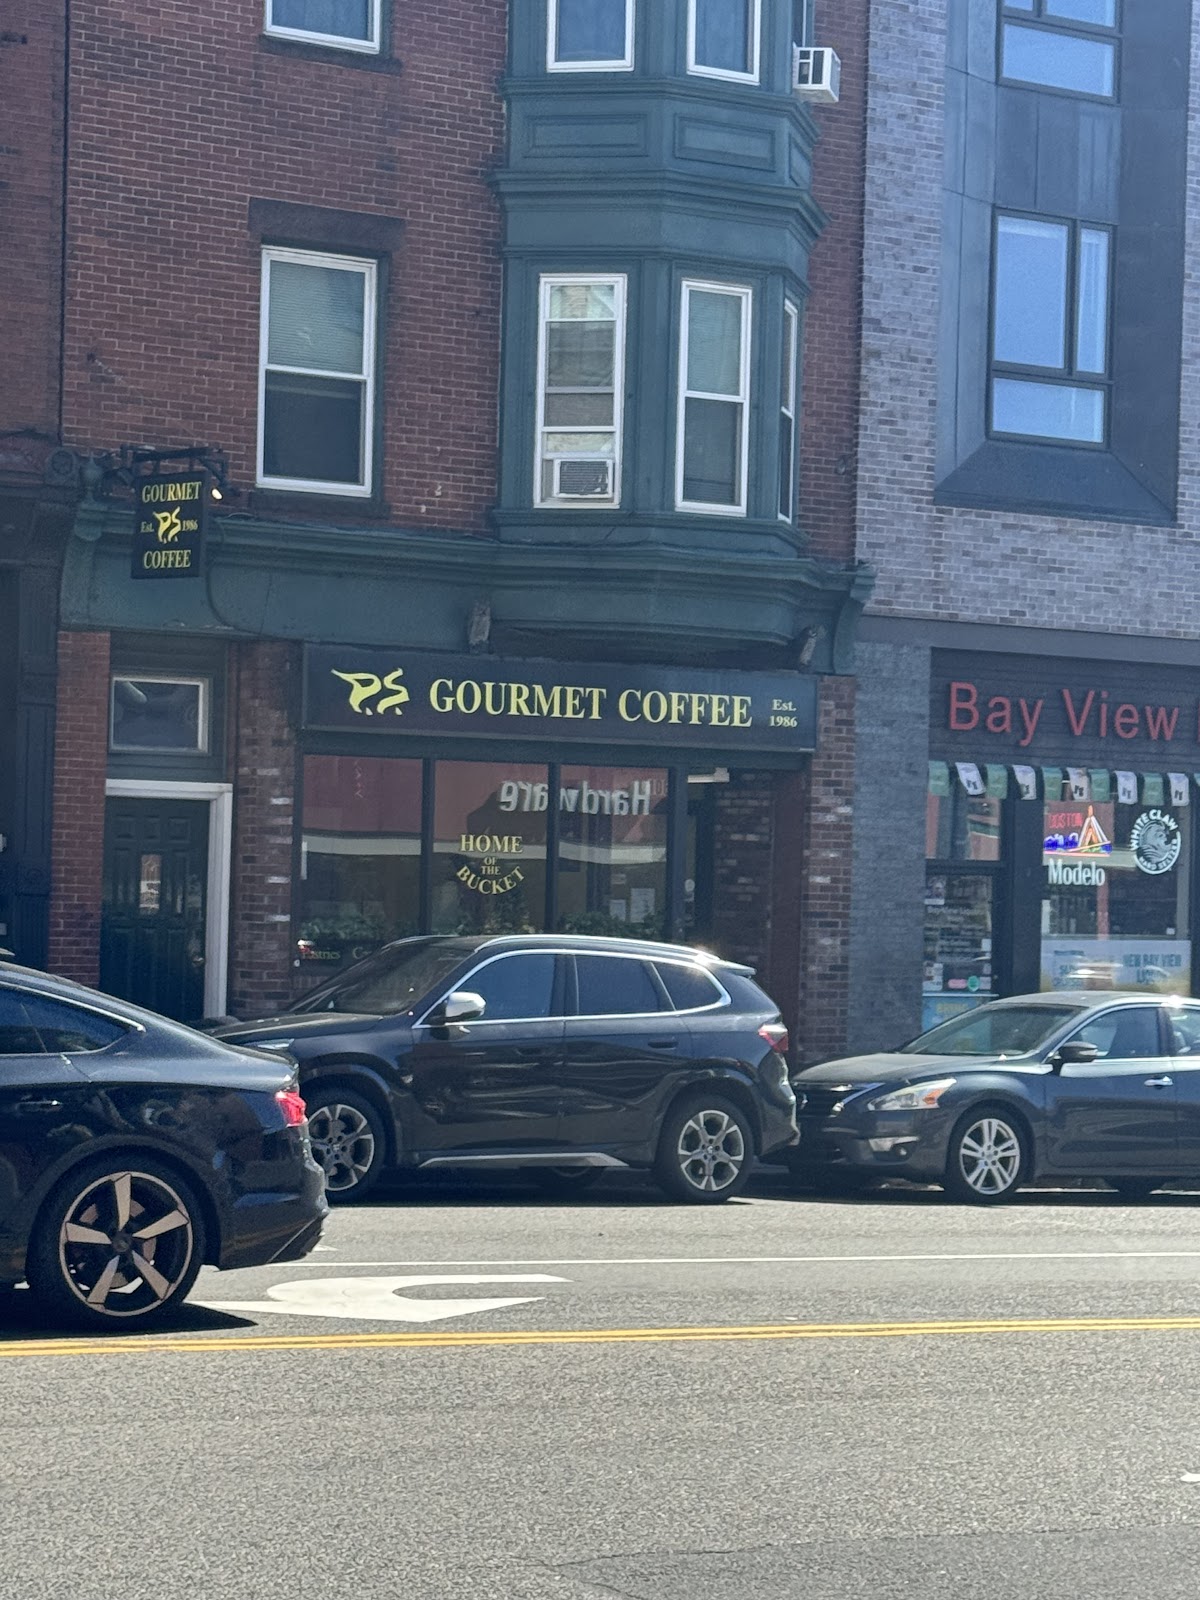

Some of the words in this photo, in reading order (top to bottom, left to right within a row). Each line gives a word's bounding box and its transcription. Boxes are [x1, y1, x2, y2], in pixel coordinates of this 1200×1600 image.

[141, 481, 202, 503] GOURMET
[140, 522, 154, 533] Est.
[182, 520, 198, 531] 1986
[143, 550, 191, 569] COFFEE
[429, 678, 606, 720] GOURMET
[618, 689, 753, 727] COFFEE
[772, 698, 796, 712] Est.
[769, 714, 798, 728] 1986
[949, 681, 1043, 747] Bay
[1063, 688, 1179, 741] View
[1129, 813, 1150, 851] WHITE
[1149, 809, 1179, 831] CLAW
[460, 834, 523, 853] HOME
[484, 856, 496, 865] OF
[456, 865, 526, 895] BUCKET
[480, 866, 501, 875] THE
[1048, 858, 1106, 886] Modelo
